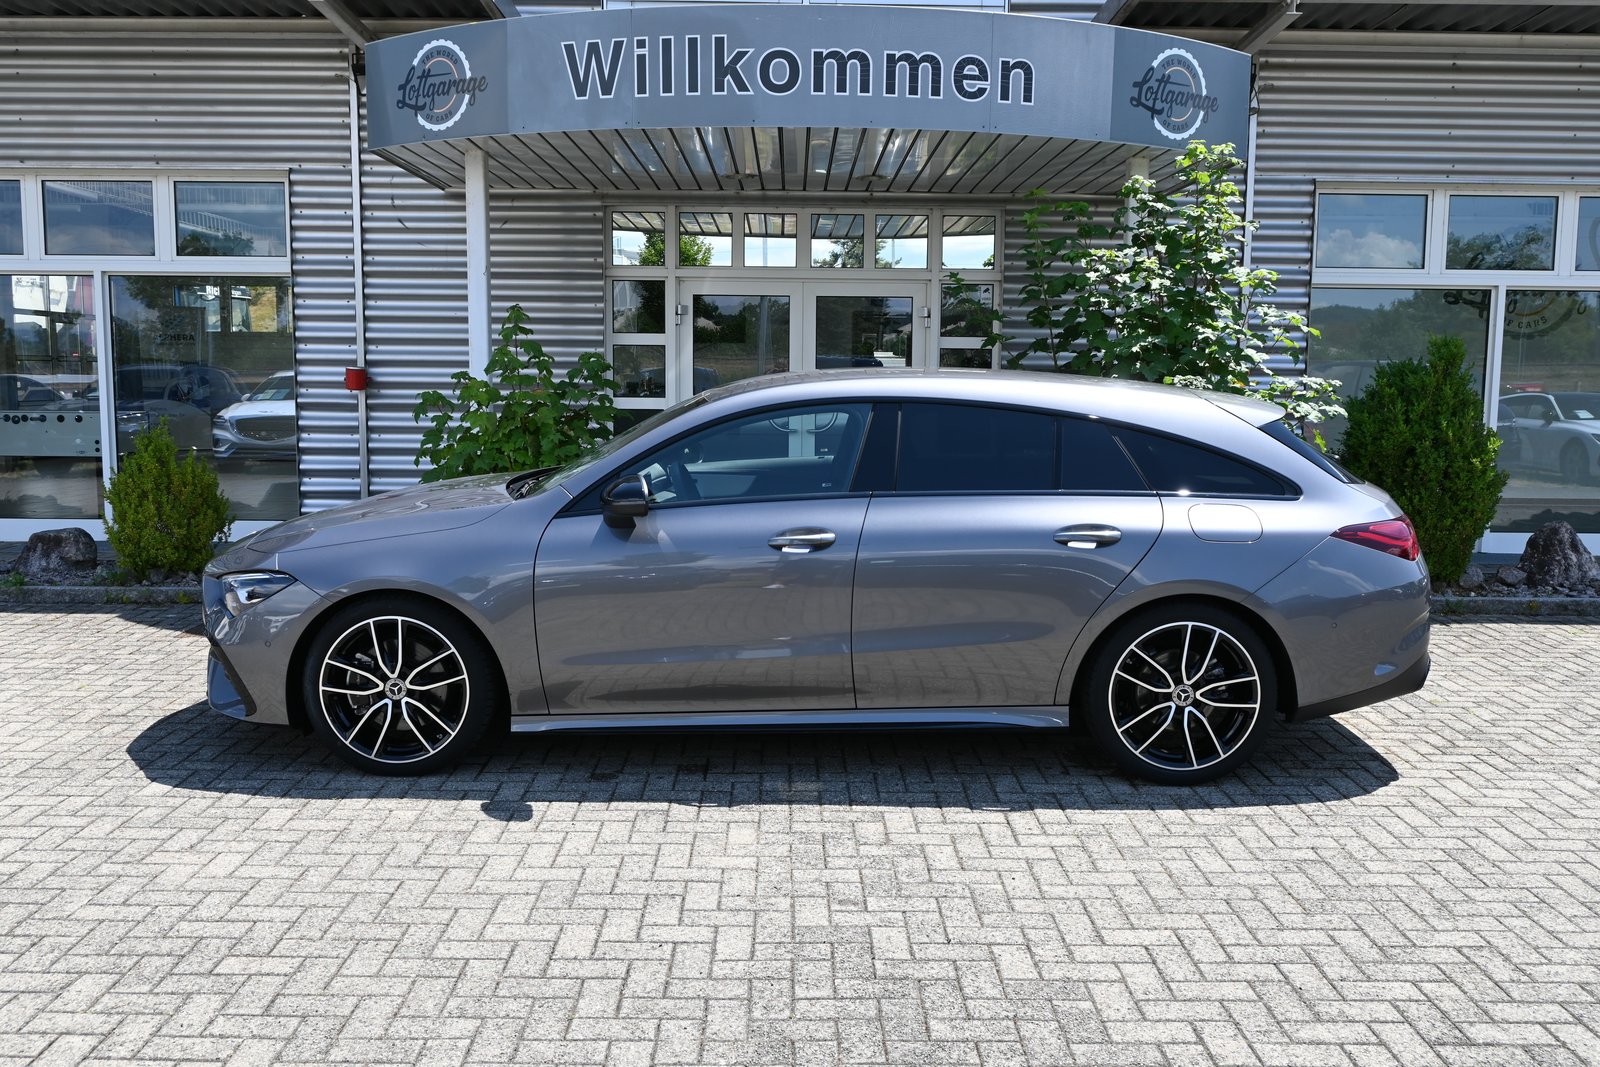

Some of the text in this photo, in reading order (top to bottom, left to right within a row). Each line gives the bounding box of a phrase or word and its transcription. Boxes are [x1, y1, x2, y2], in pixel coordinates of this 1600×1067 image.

[422, 50, 458, 65] THE WORLD
[561, 35, 1035, 105] Willkommen
[1162, 59, 1197, 80] THE WORLD
[397, 65, 488, 117] Loftgarage
[1130, 65, 1219, 123] Loftgarage
[425, 110, 452, 122] OF CARS
[1163, 120, 1189, 131] OF CARS
[1518, 315, 1547, 329] CARS
